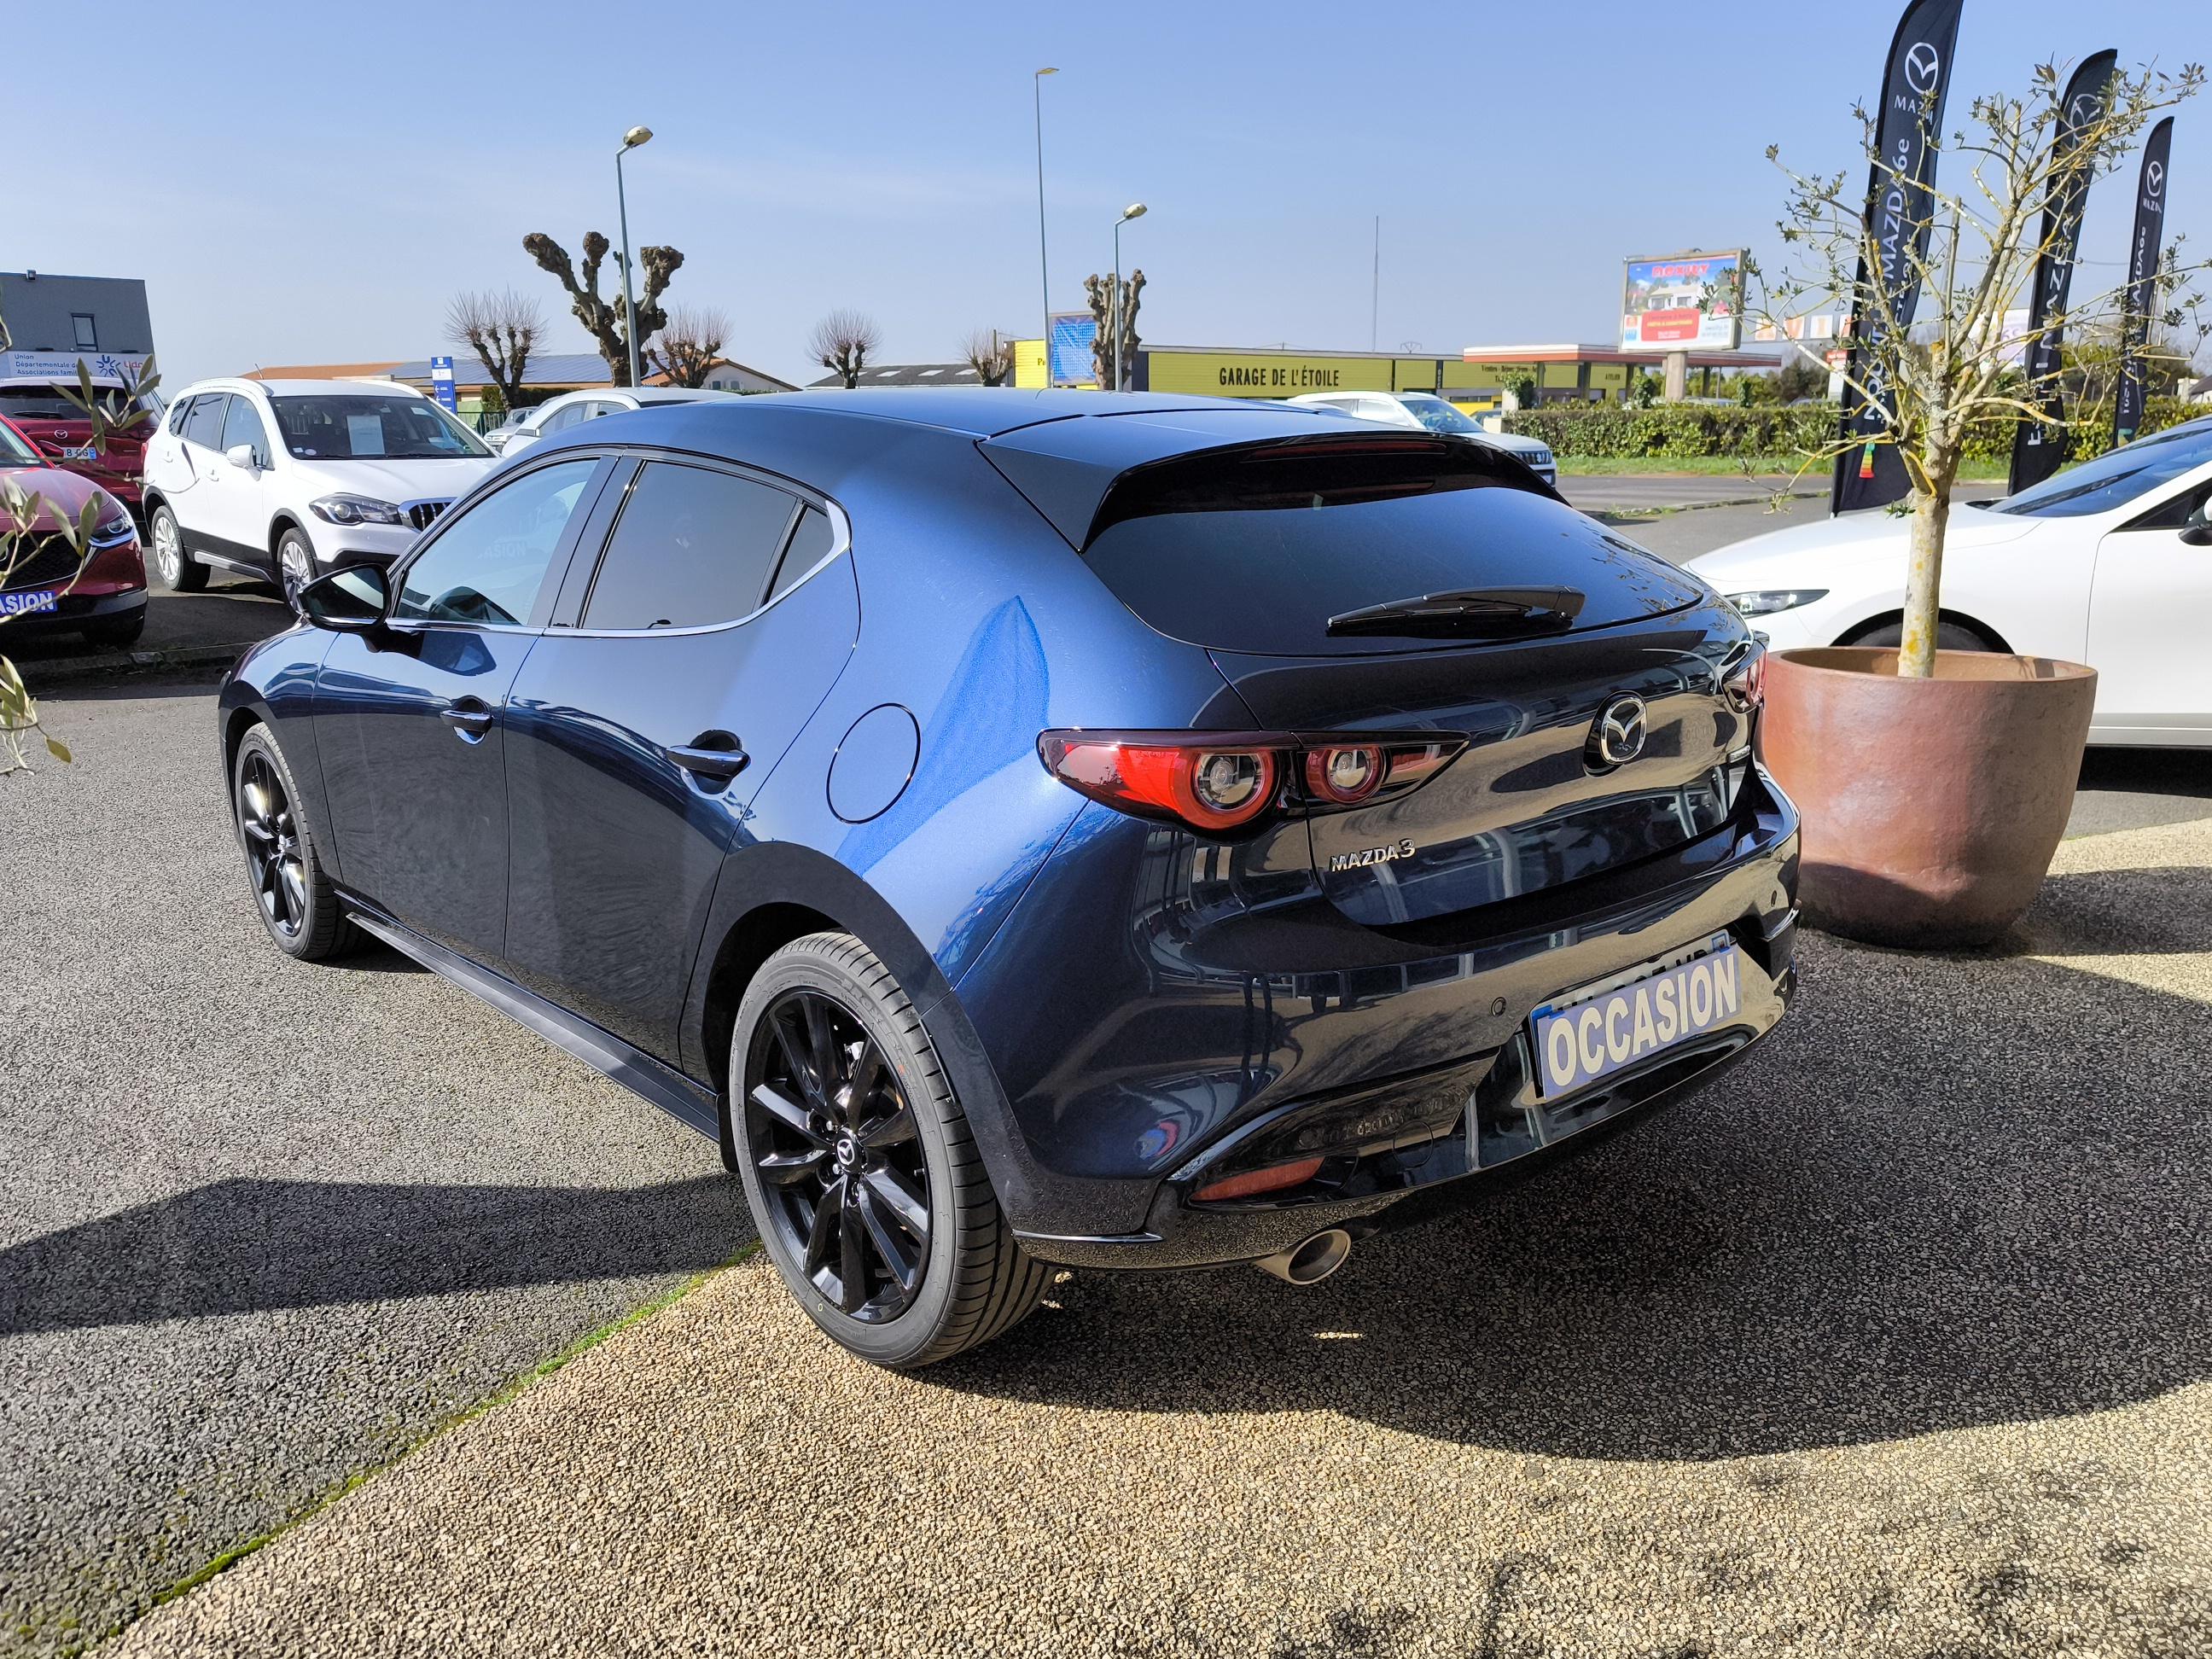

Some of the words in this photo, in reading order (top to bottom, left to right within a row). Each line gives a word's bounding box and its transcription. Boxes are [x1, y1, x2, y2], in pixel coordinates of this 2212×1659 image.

[1220, 368, 1266, 386] GARAGE
[1272, 369, 1286, 386] DE
[1291, 365, 1339, 387] L'ÉTOILE
[1547, 953, 1738, 1086] OCCASION
